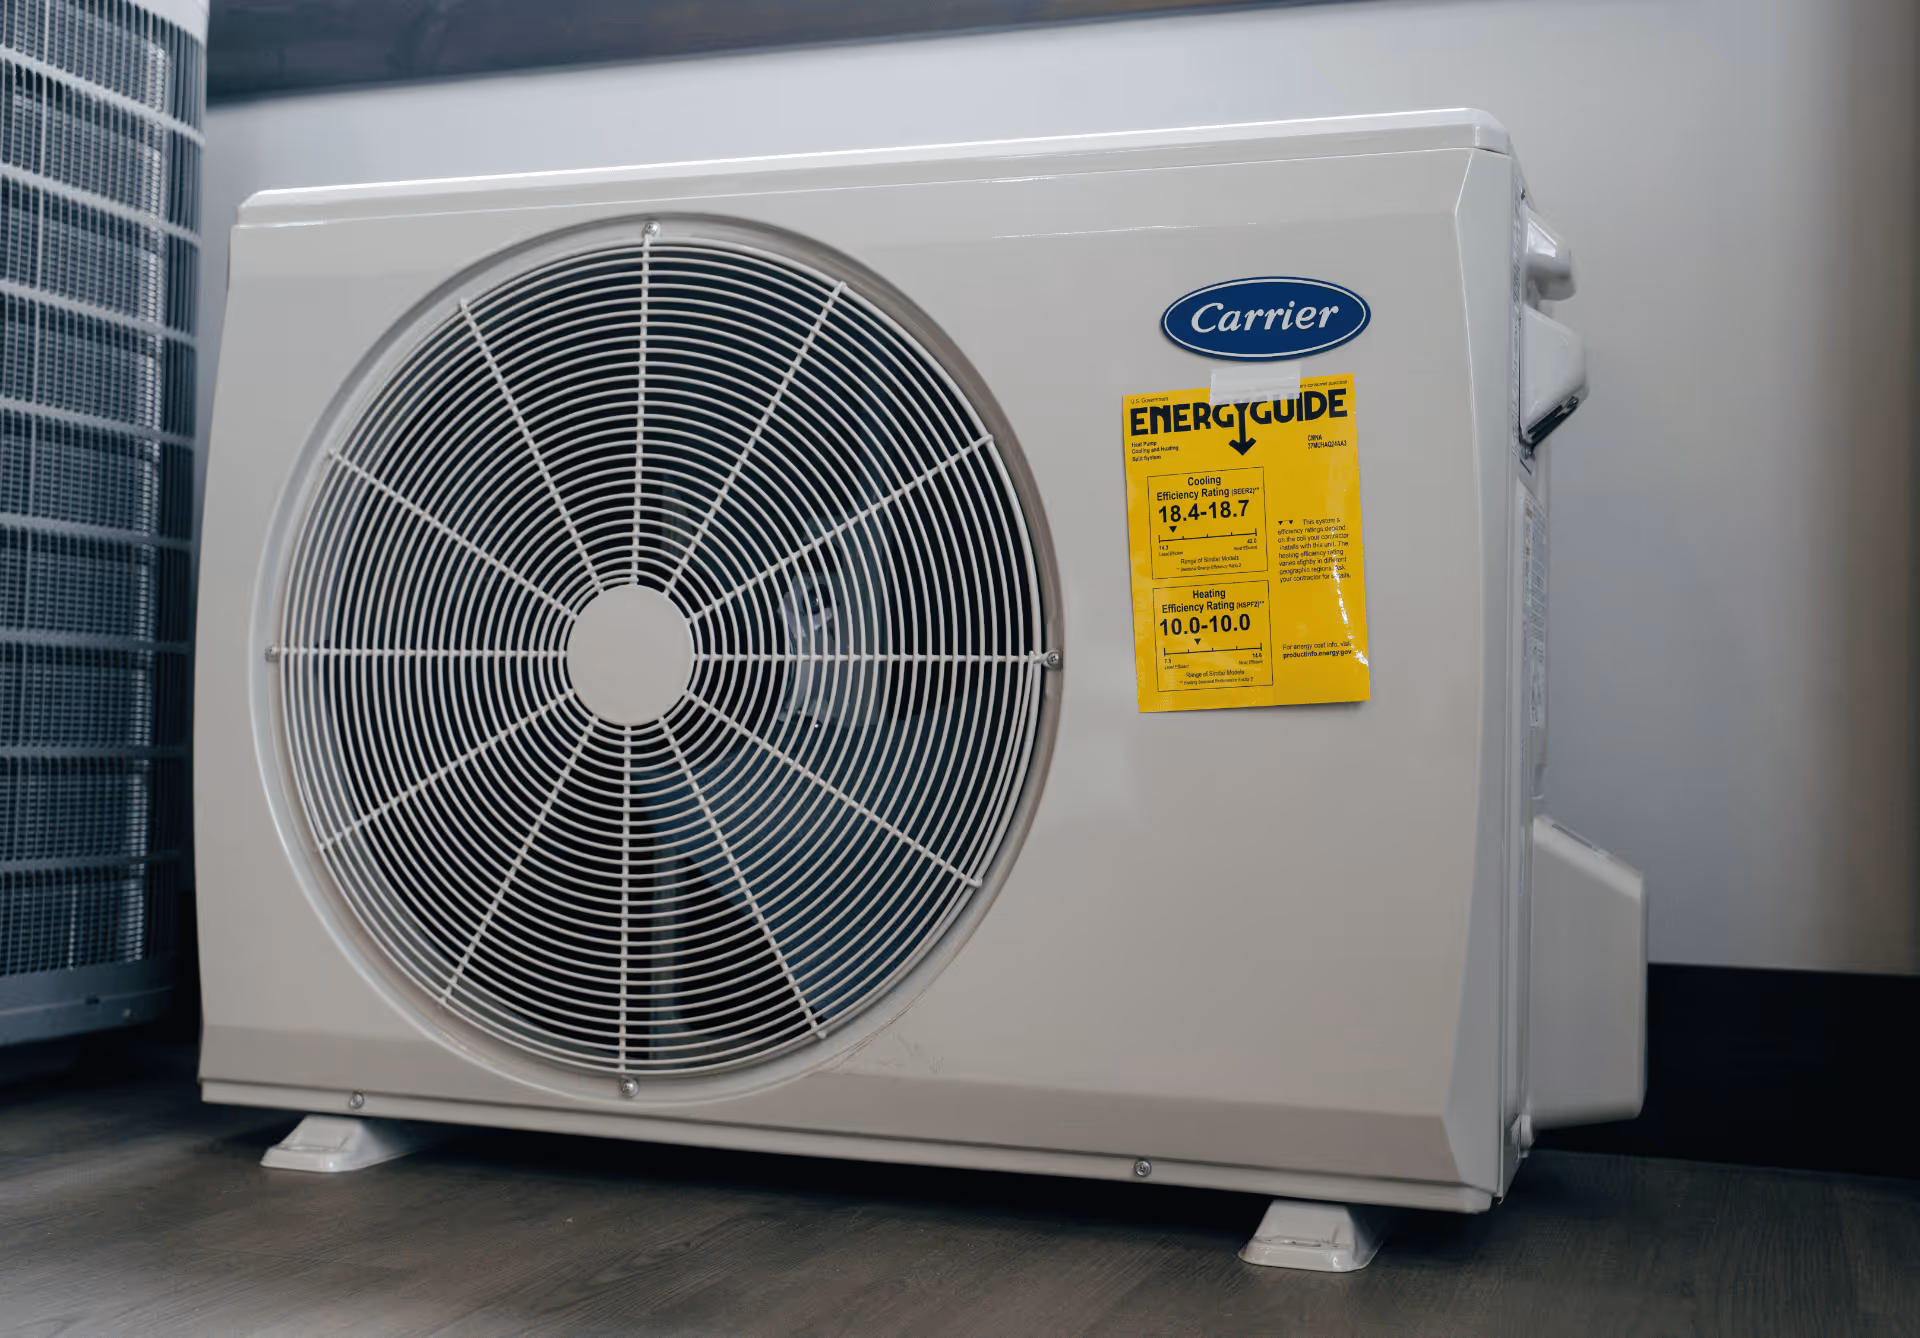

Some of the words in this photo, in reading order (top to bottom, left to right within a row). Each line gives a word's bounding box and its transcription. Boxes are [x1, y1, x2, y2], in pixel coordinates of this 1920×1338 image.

[1190, 300, 1339, 334] Carrier
[1188, 476, 1221, 486] Cooling
[1157, 490, 1199, 501] Efficiency
[1202, 487, 1230, 497] Rating
[1159, 500, 1249, 523] 18.4-18.7
[1193, 589, 1226, 599] Heating
[1162, 604, 1204, 614] Efficiency
[1207, 601, 1234, 611] Rating
[1160, 614, 1250, 636] 10.0-10.0
